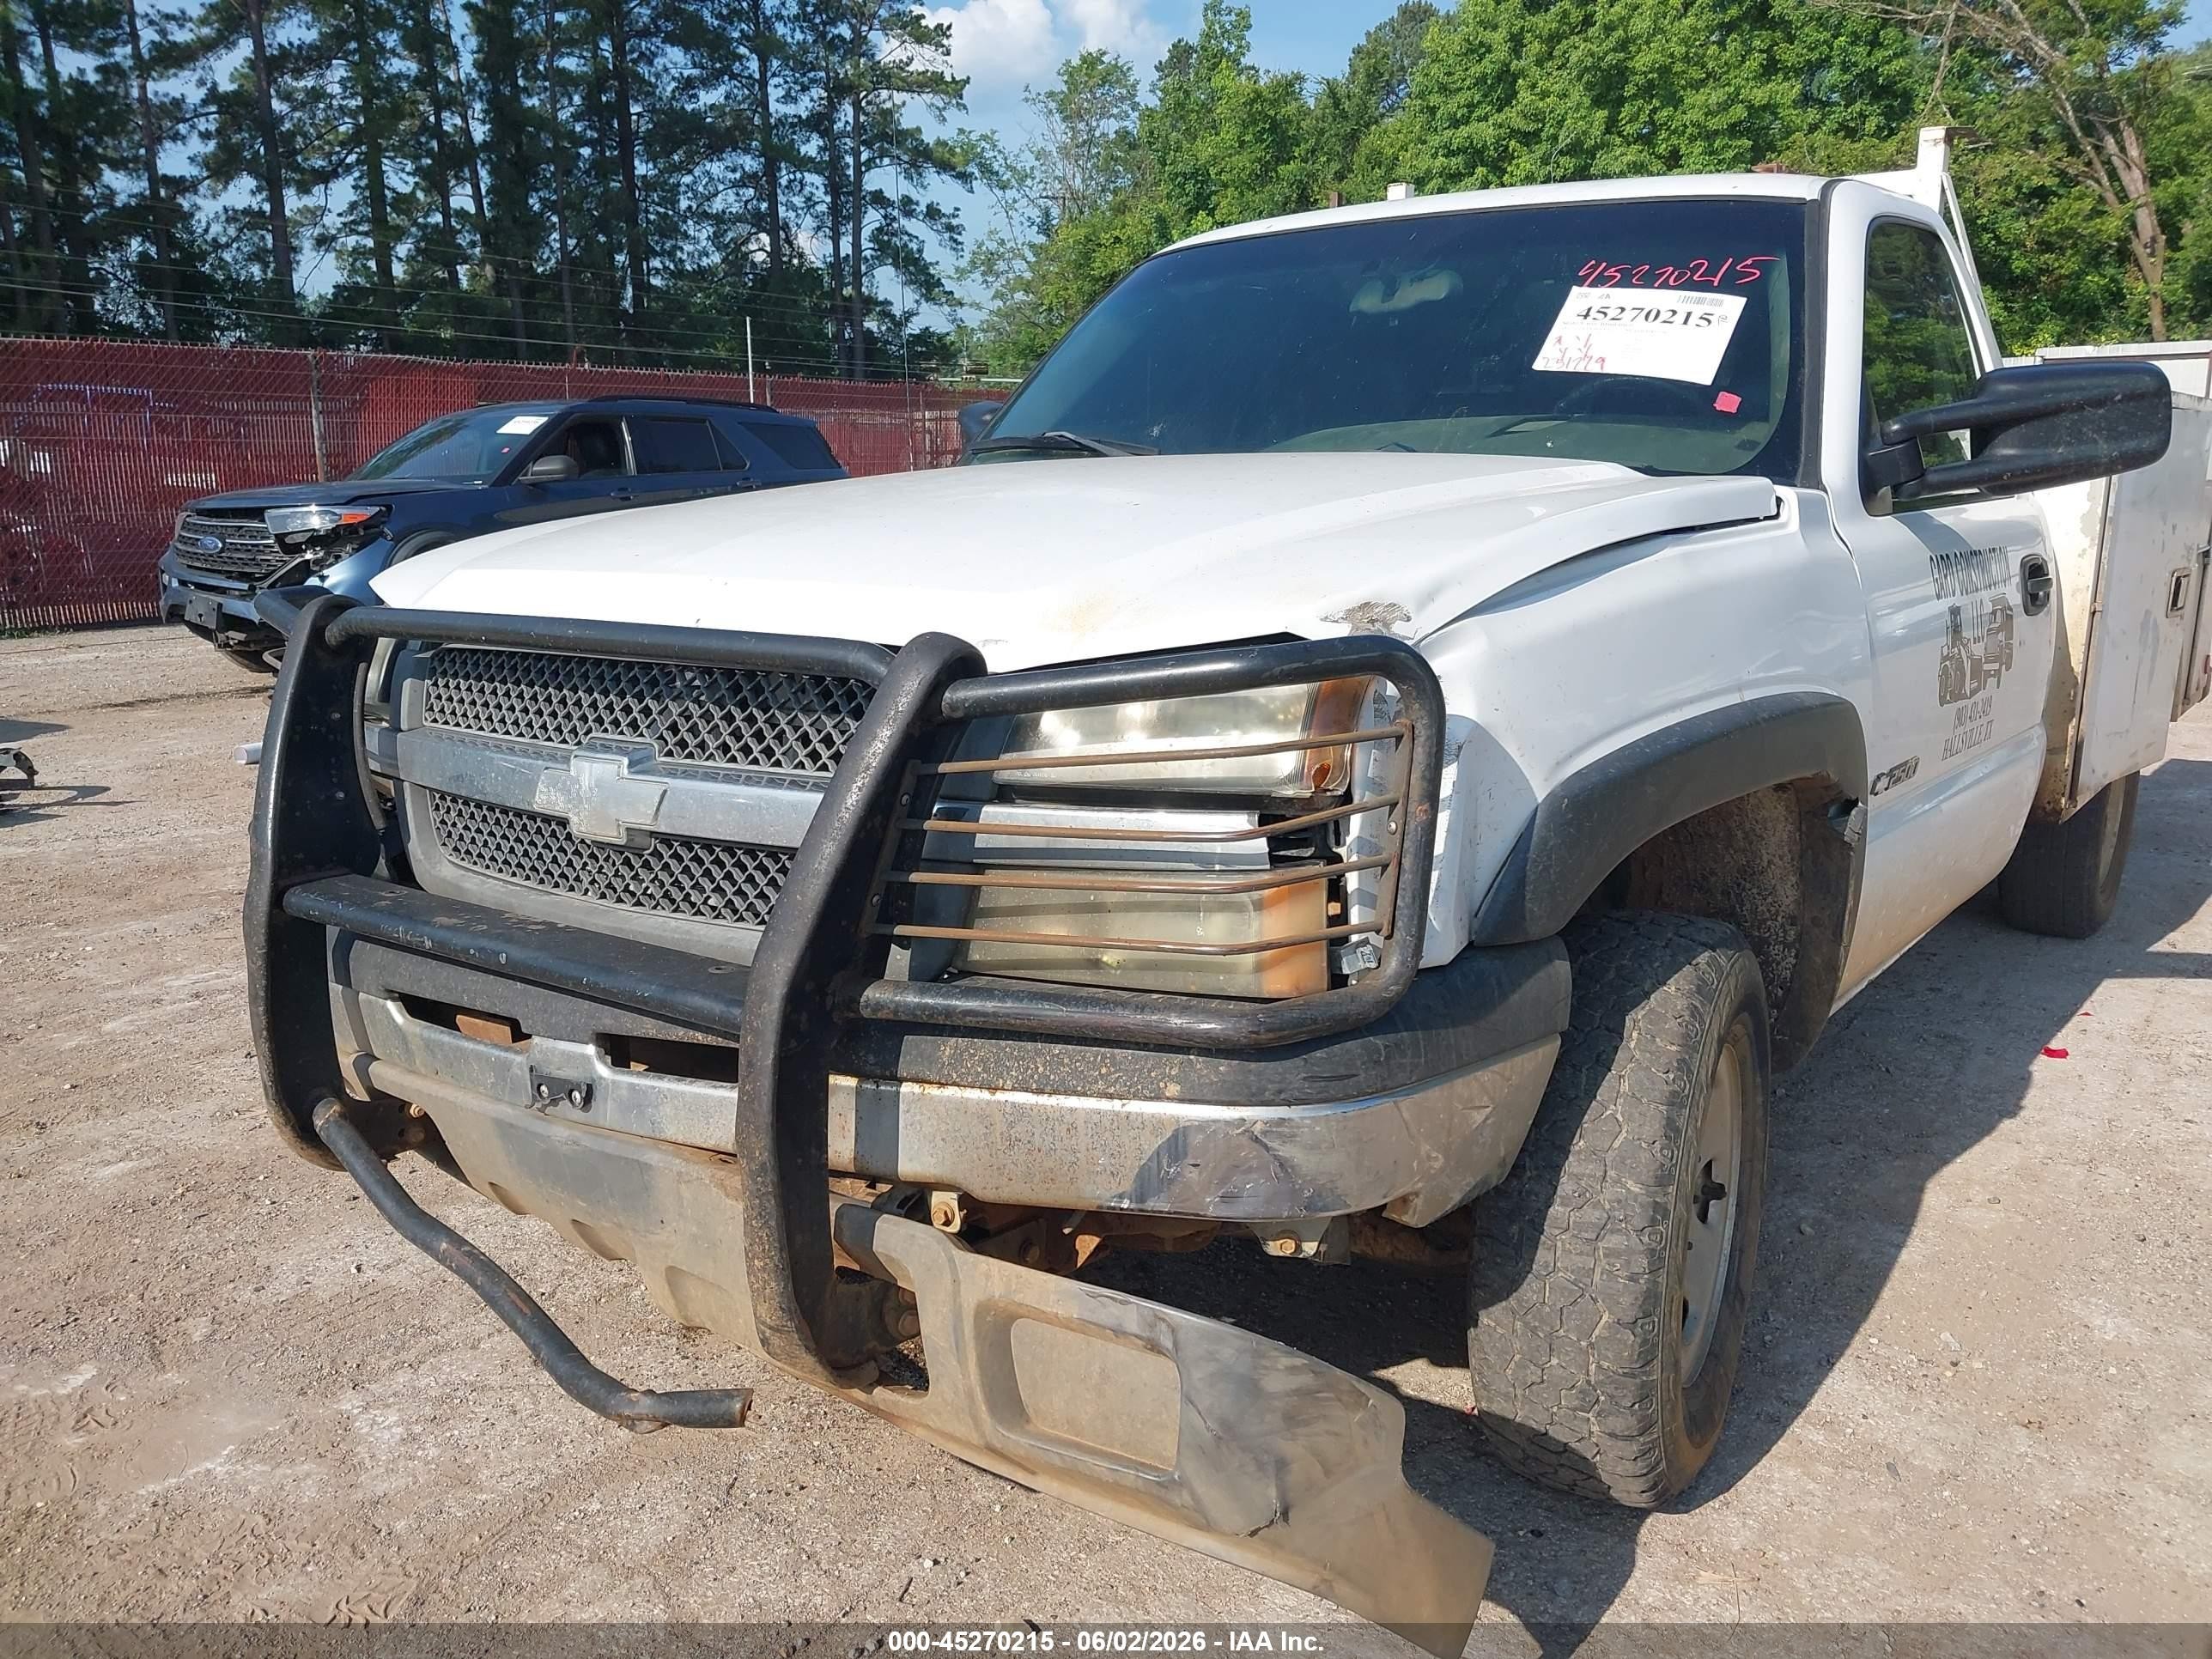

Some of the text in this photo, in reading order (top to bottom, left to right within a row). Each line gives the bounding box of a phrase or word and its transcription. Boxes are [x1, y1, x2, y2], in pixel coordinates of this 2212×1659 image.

[1577, 255, 1781, 289] 45270215
[1576, 305, 1715, 328] 45270215
[1929, 545, 2012, 602] GARD CONSTRUCTION
[1971, 598, 1985, 645] LLC
